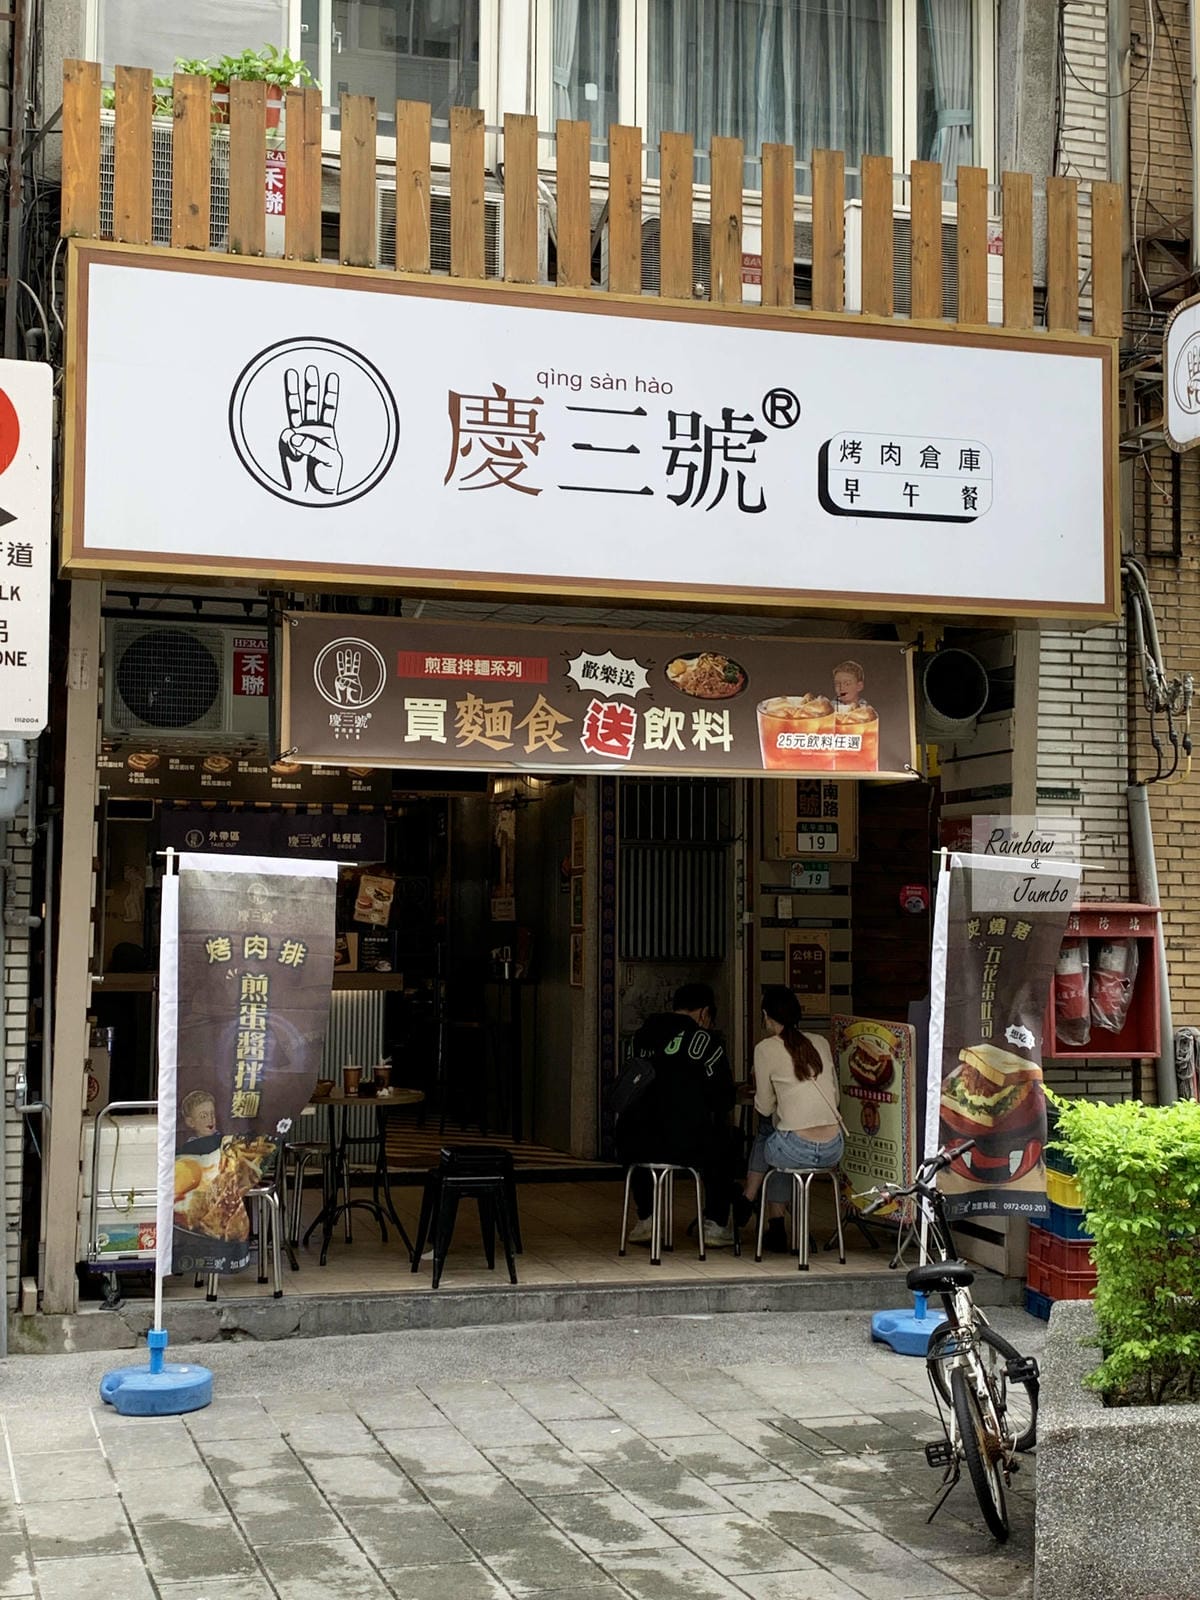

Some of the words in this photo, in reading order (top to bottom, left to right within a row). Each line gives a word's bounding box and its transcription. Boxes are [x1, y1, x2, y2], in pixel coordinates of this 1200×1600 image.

[536, 368, 583, 391] qìng
[590, 374, 626, 392] sàn
[635, 376, 673, 395] hào
[839, 439, 981, 472] 烤肉倉庫
[843, 478, 978, 511] 早午餐
[0, 542, 34, 568] 道
[241, 654, 265, 695] 禾聯
[424, 656, 523, 678] 煎蛋拌麵系列
[581, 660, 636, 689] 歡樂送
[777, 733, 861, 751] 25元飲料任選
[208, 831, 240, 842] 外帶區
[332, 833, 362, 844] 點餐區
[808, 835, 825, 850] 19
[808, 873, 822, 885] 19
[967, 917, 1032, 940] 炭燒豬
[205, 934, 306, 968] 烤肉排
[792, 950, 823, 961] 公休日
[981, 946, 1003, 1039] 五花蛋吐司
[231, 972, 268, 1118] 煎蛋醬拌麵
[1003, 1203, 1047, 1212] 0972-003-203
